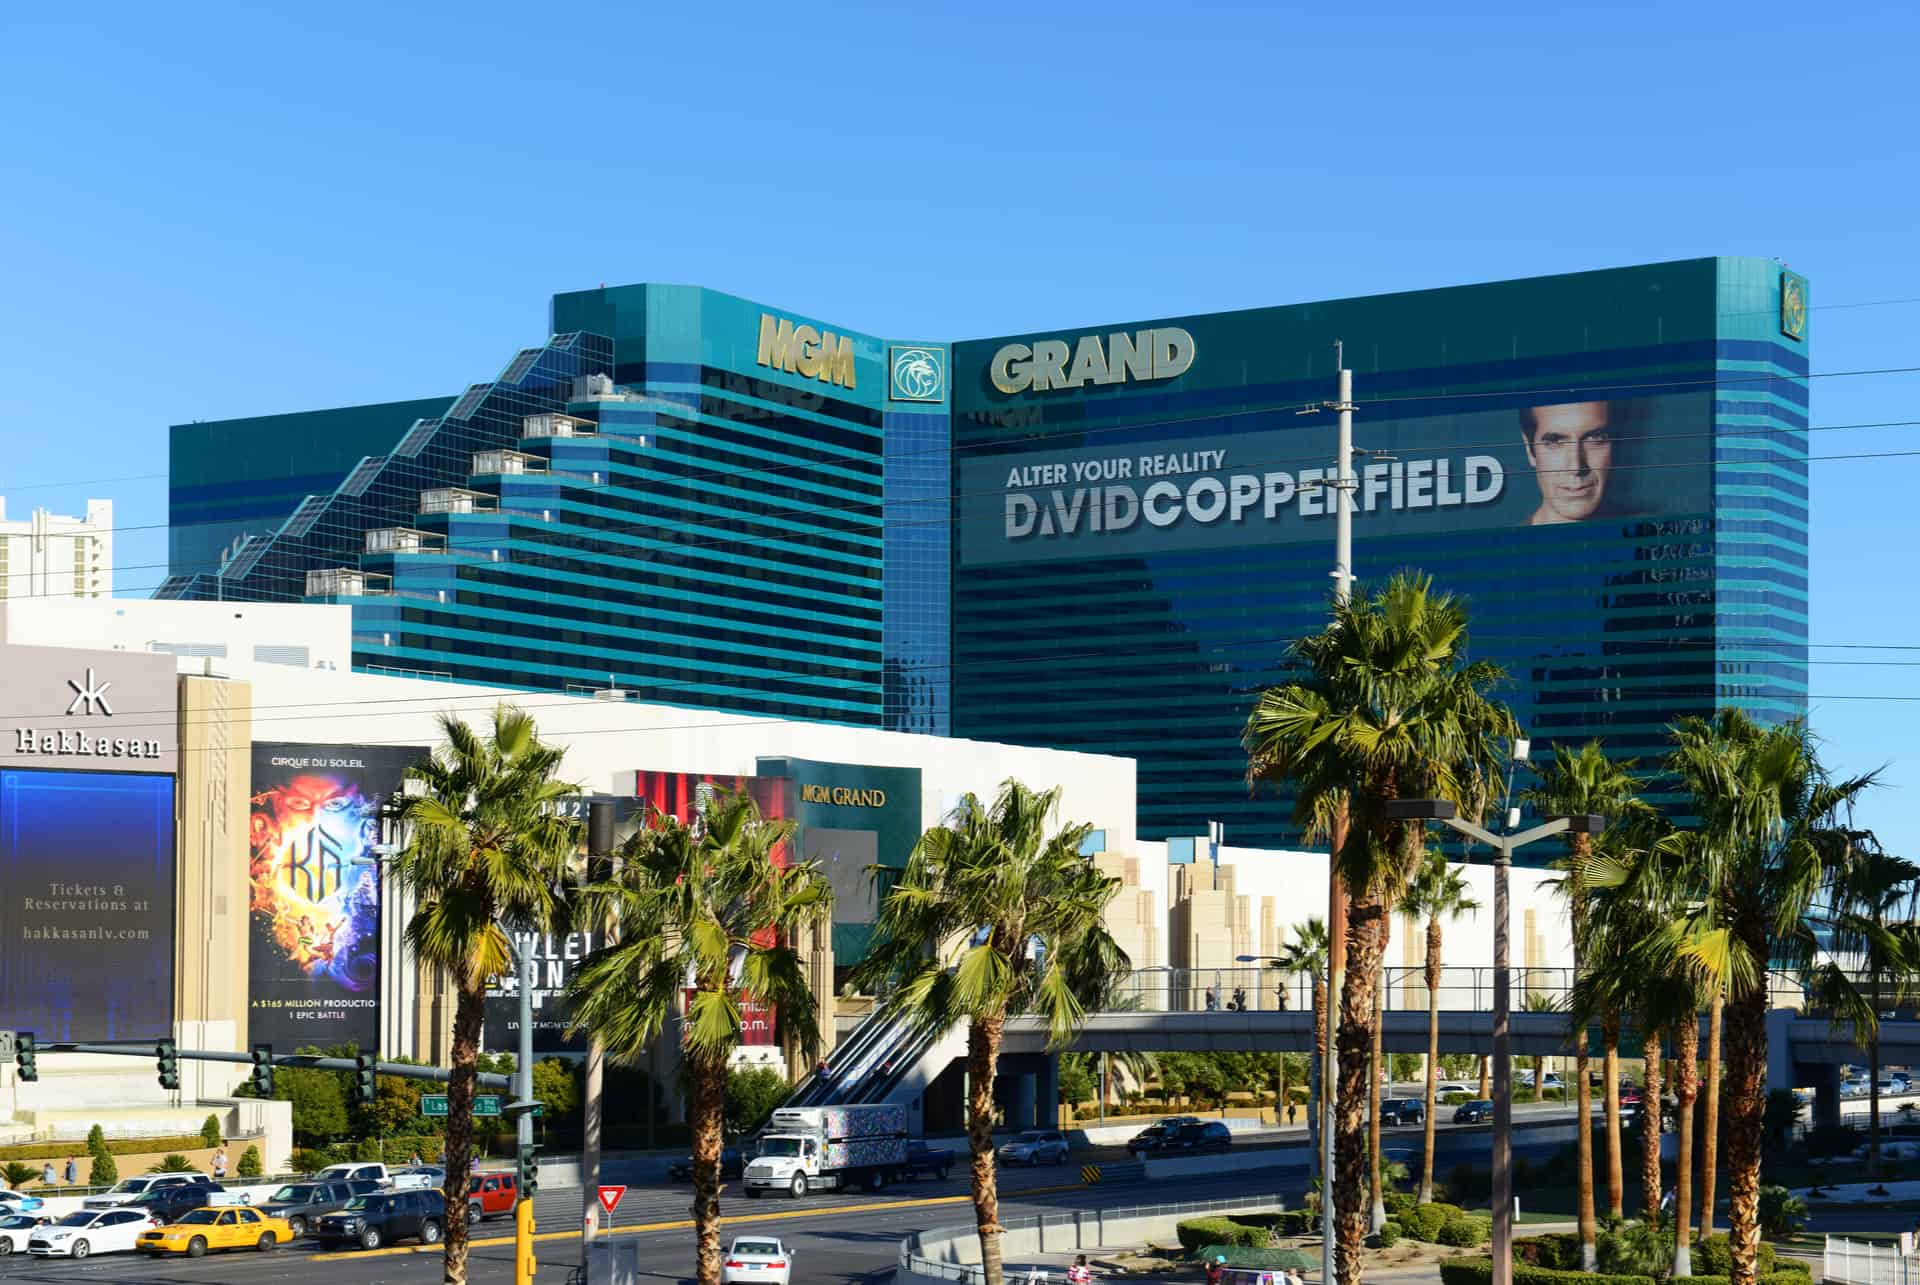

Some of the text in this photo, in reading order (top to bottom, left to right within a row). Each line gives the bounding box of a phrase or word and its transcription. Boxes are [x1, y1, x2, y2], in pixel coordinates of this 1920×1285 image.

[757, 312, 856, 389] MGM
[989, 327, 1196, 394] GRAND
[1006, 450, 1226, 488] ALTER YOUR REALITY
[15, 727, 161, 758] Hakkasan
[271, 757, 366, 769] CIRQUE DU SOLEIL
[802, 783, 886, 807] MGM GRAND
[49, 883, 125, 897] Tickets &
[24, 897, 149, 911] Reservations at
[23, 926, 150, 940] hakkasanlv.com
[252, 1000, 259, 1008] A
[285, 999, 321, 1008] MILLION
[296, 1011, 316, 1019] EPIC
[318, 1011, 345, 1019] BATTLE
